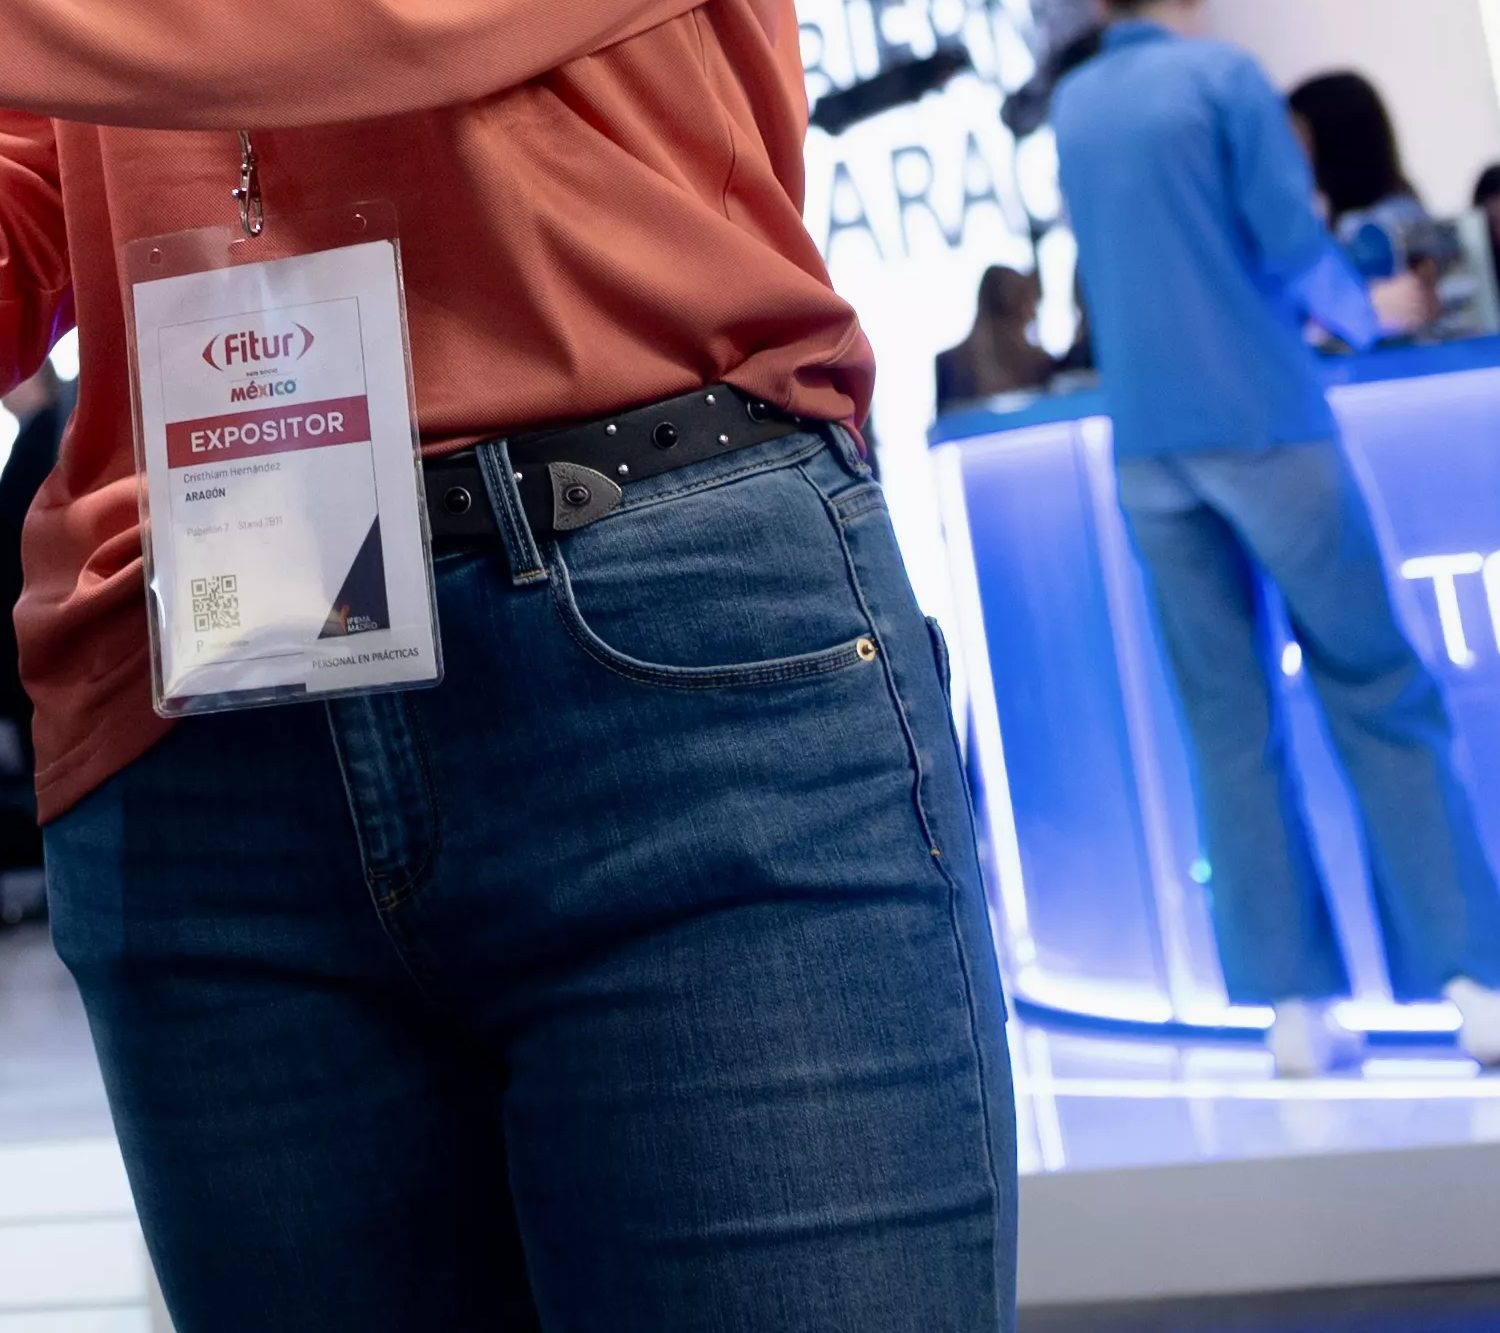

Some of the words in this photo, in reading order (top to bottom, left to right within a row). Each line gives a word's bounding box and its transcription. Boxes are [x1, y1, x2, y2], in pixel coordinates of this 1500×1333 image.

[223, 330, 295, 366] Fitur
[190, 411, 345, 454] EXPOSITOR
[184, 486, 226, 503] ARAGÓN
[311, 655, 357, 669] PERSONAL
[357, 653, 371, 665] EN
[371, 646, 420, 662] PRÁCTICAS
